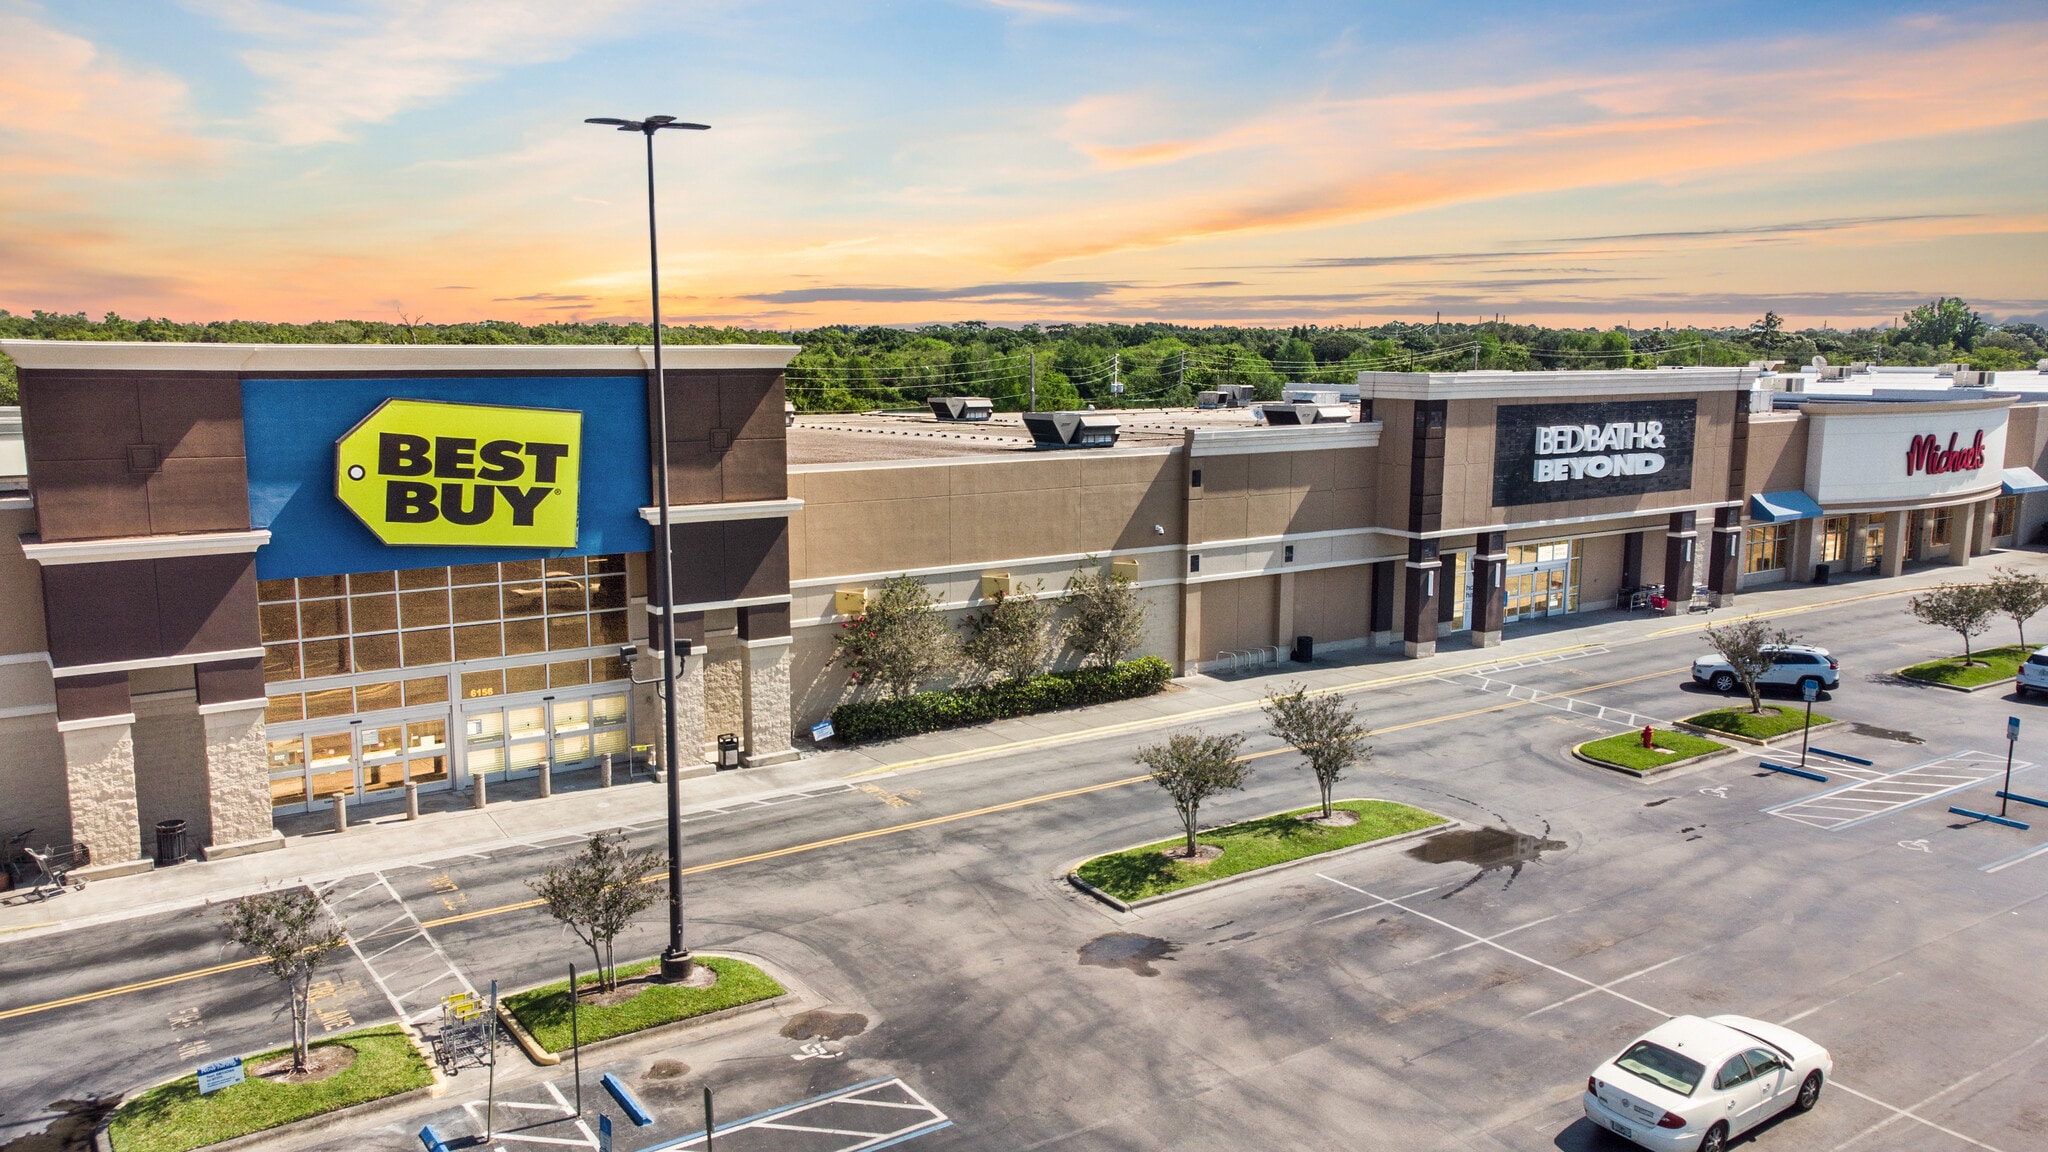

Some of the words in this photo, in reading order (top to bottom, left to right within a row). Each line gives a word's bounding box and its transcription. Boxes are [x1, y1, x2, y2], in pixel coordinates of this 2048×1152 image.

[378, 432, 569, 483] BEST
[1533, 453, 1666, 482] BEYOND
[1906, 429, 1985, 476] Michaels
[385, 480, 554, 526] BUY
[470, 687, 493, 697] 6156
